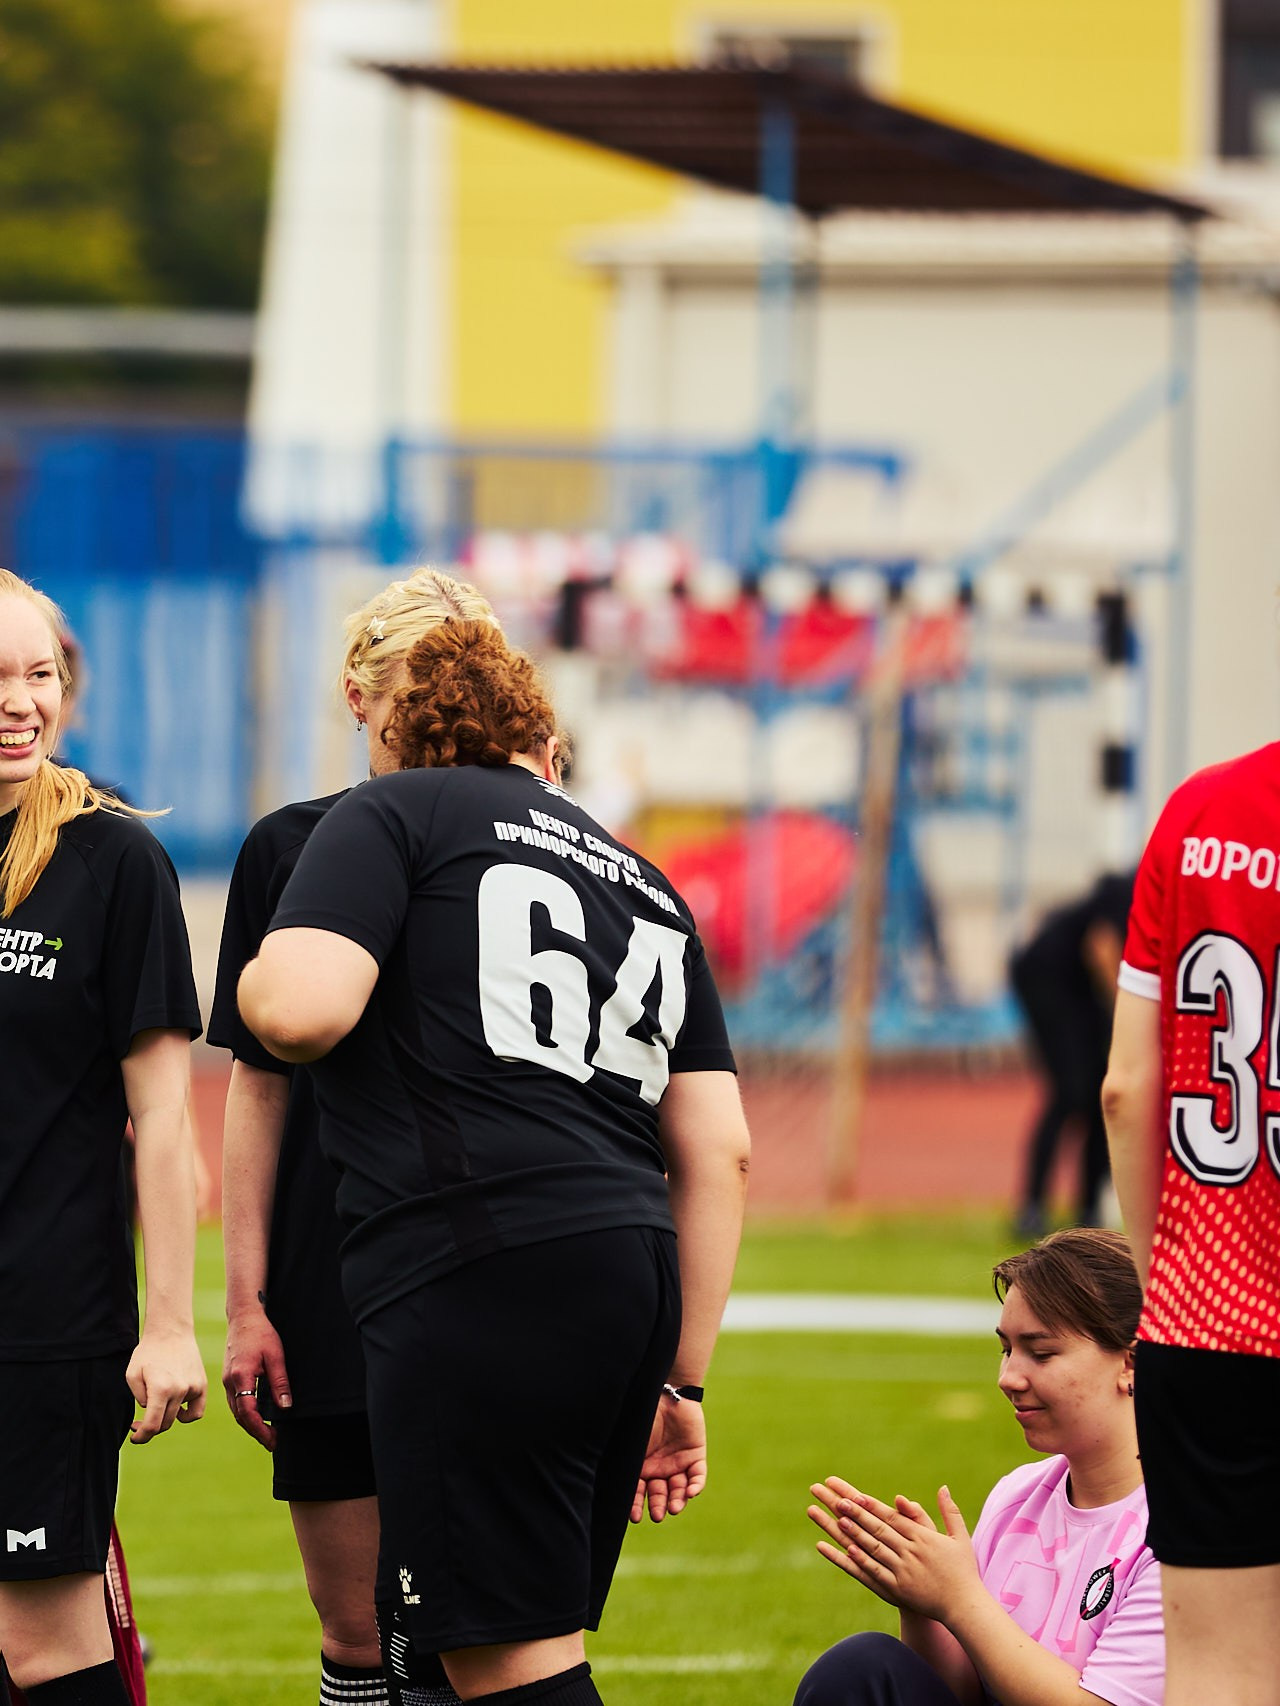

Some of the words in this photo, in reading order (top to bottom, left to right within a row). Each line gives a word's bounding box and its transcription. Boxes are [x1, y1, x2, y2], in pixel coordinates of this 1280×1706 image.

[493, 821, 620, 883] ПРИМОРСКОГО
[528, 808, 581, 843] ЦЕНТР
[1180, 836, 1280, 892] ВОРО
[478, 863, 689, 1106] 64
[1169, 930, 1280, 1187] 3
